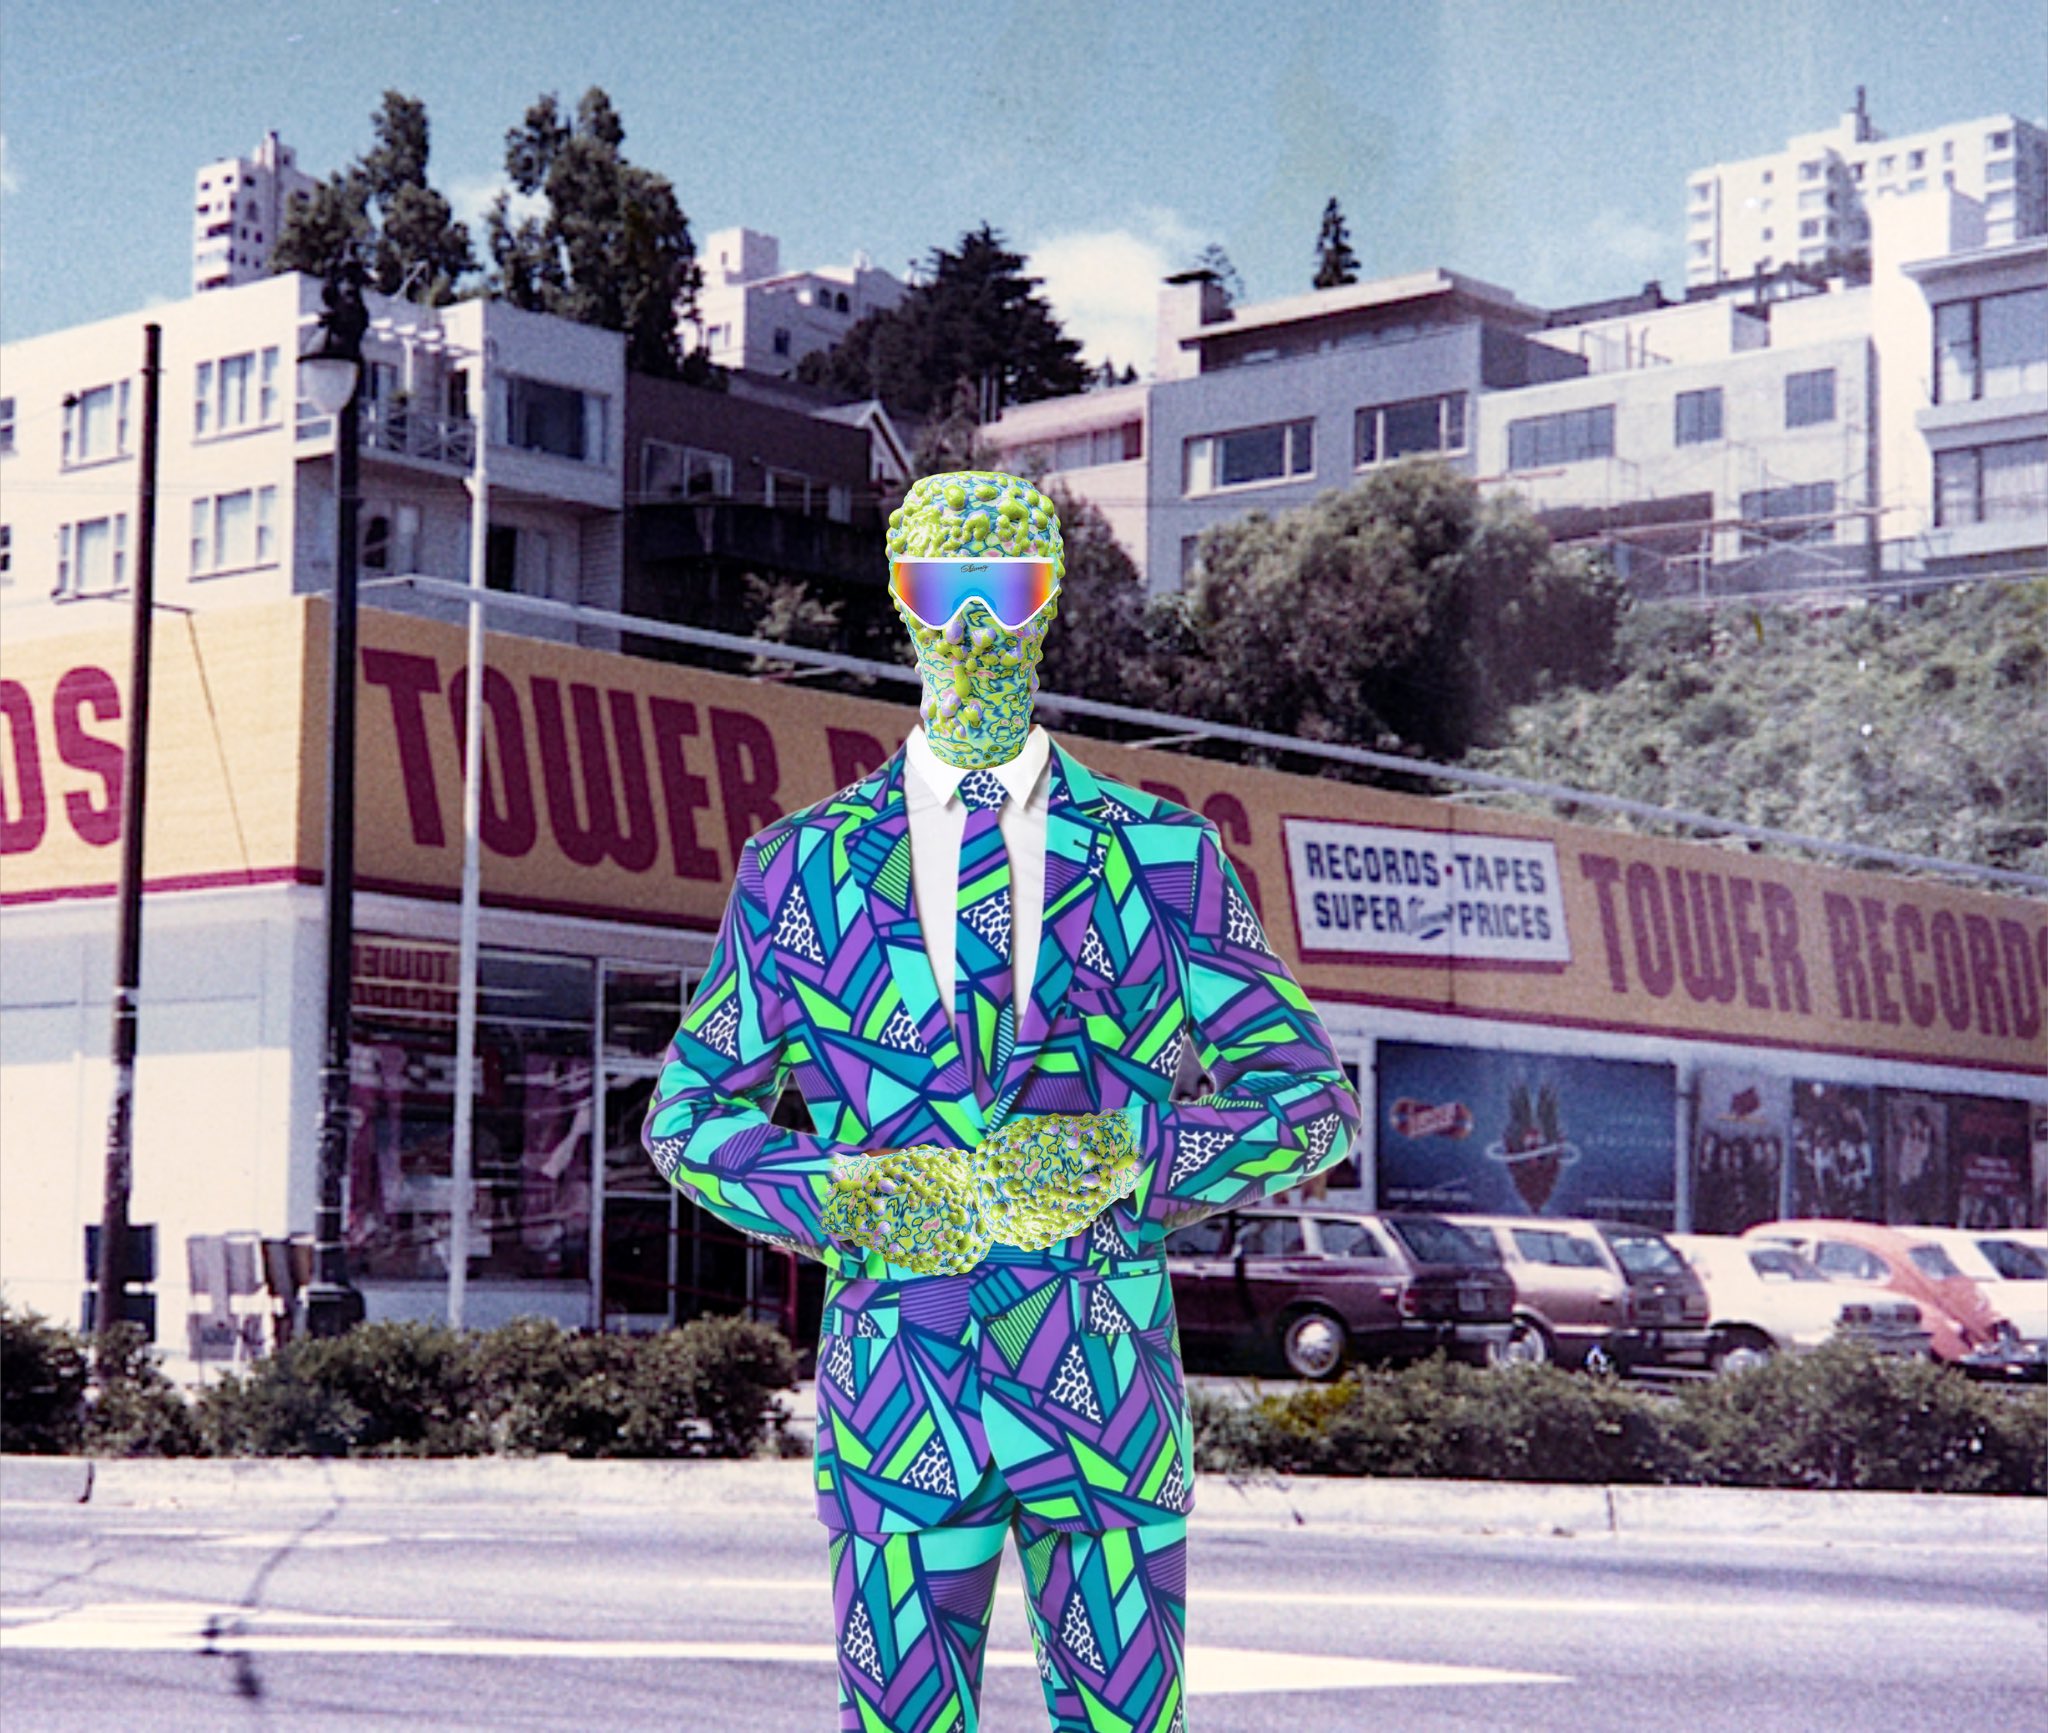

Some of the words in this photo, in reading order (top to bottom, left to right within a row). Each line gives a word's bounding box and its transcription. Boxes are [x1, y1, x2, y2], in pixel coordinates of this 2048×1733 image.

[362, 647, 784, 882] TOWER
[1313, 891, 1405, 934] SUPER
[1458, 901, 1552, 941] PRICES
[1454, 853, 1546, 894] TAPES
[1579, 853, 1812, 1014] TOWER
[1824, 891, 2048, 1041] RECORD
